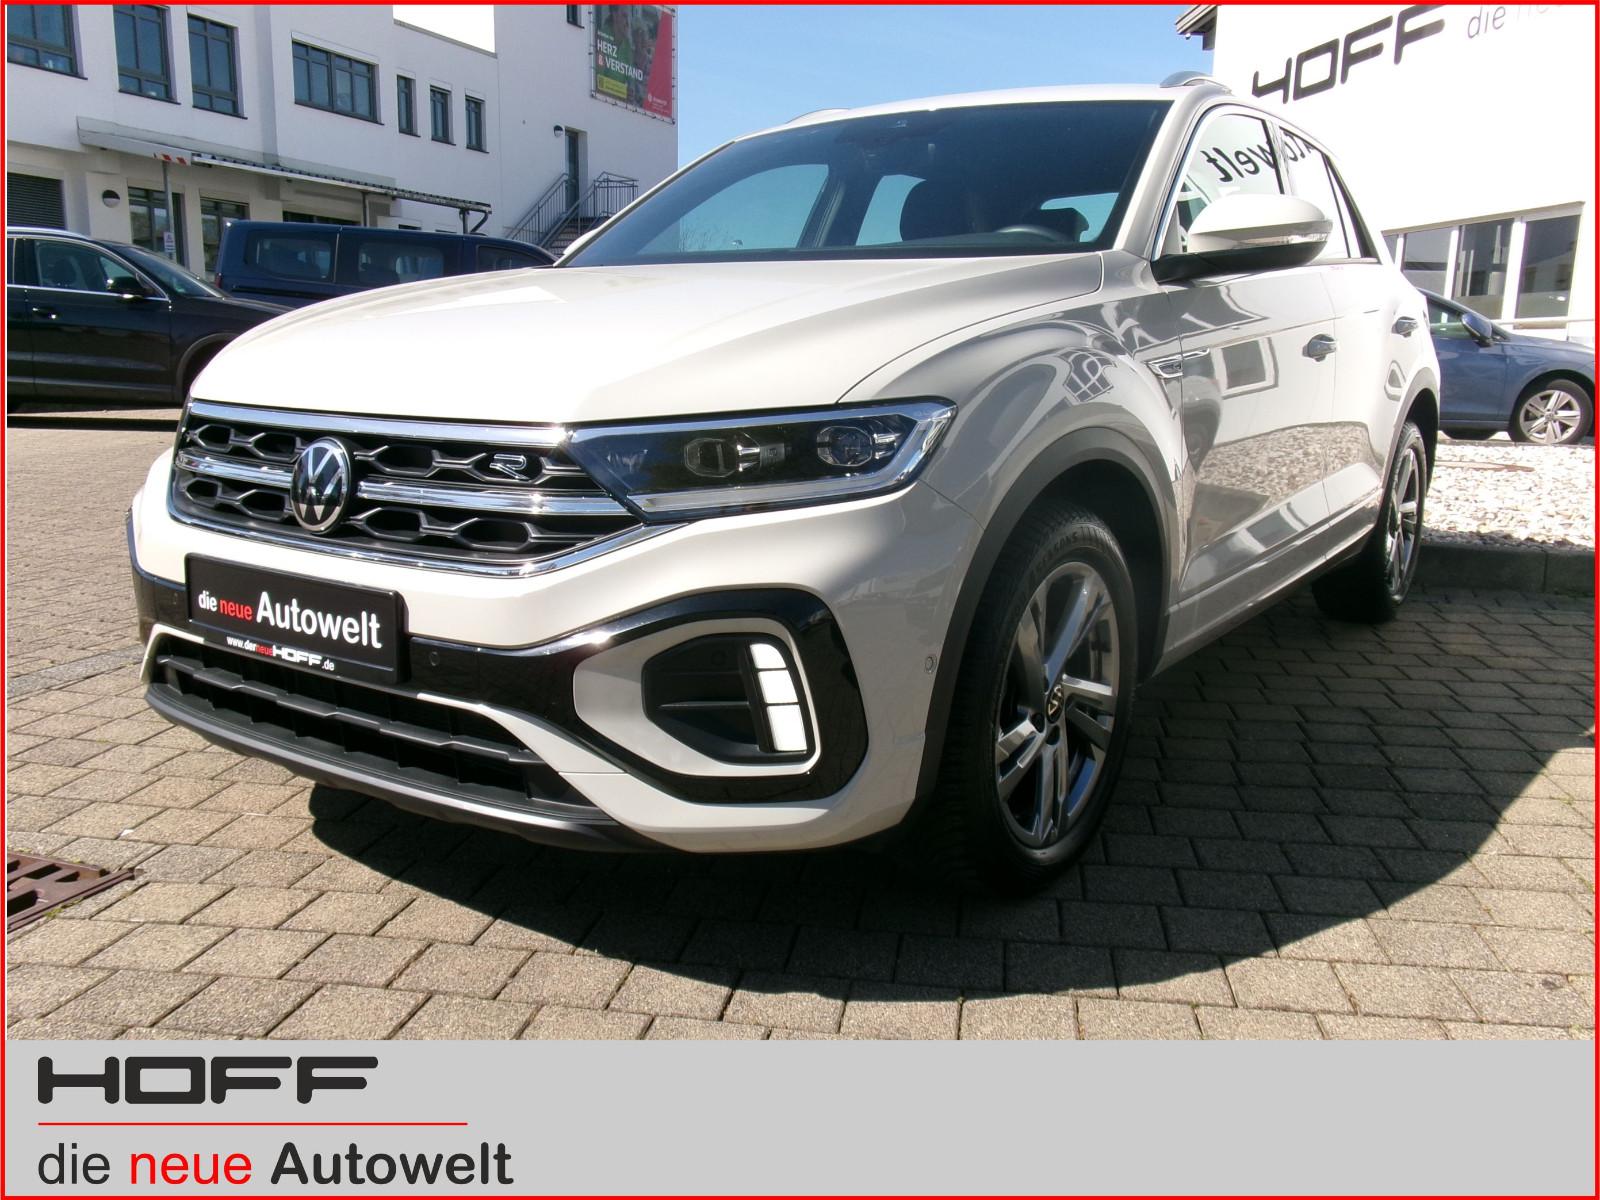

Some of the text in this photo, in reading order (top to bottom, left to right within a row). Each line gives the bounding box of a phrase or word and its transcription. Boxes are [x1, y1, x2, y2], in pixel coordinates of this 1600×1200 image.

[597, 39, 617, 58] HERZ
[605, 56, 643, 81] VERSTAND
[1252, 5, 1506, 104] HOFF die
[198, 590, 382, 649] die neue Autowelt
